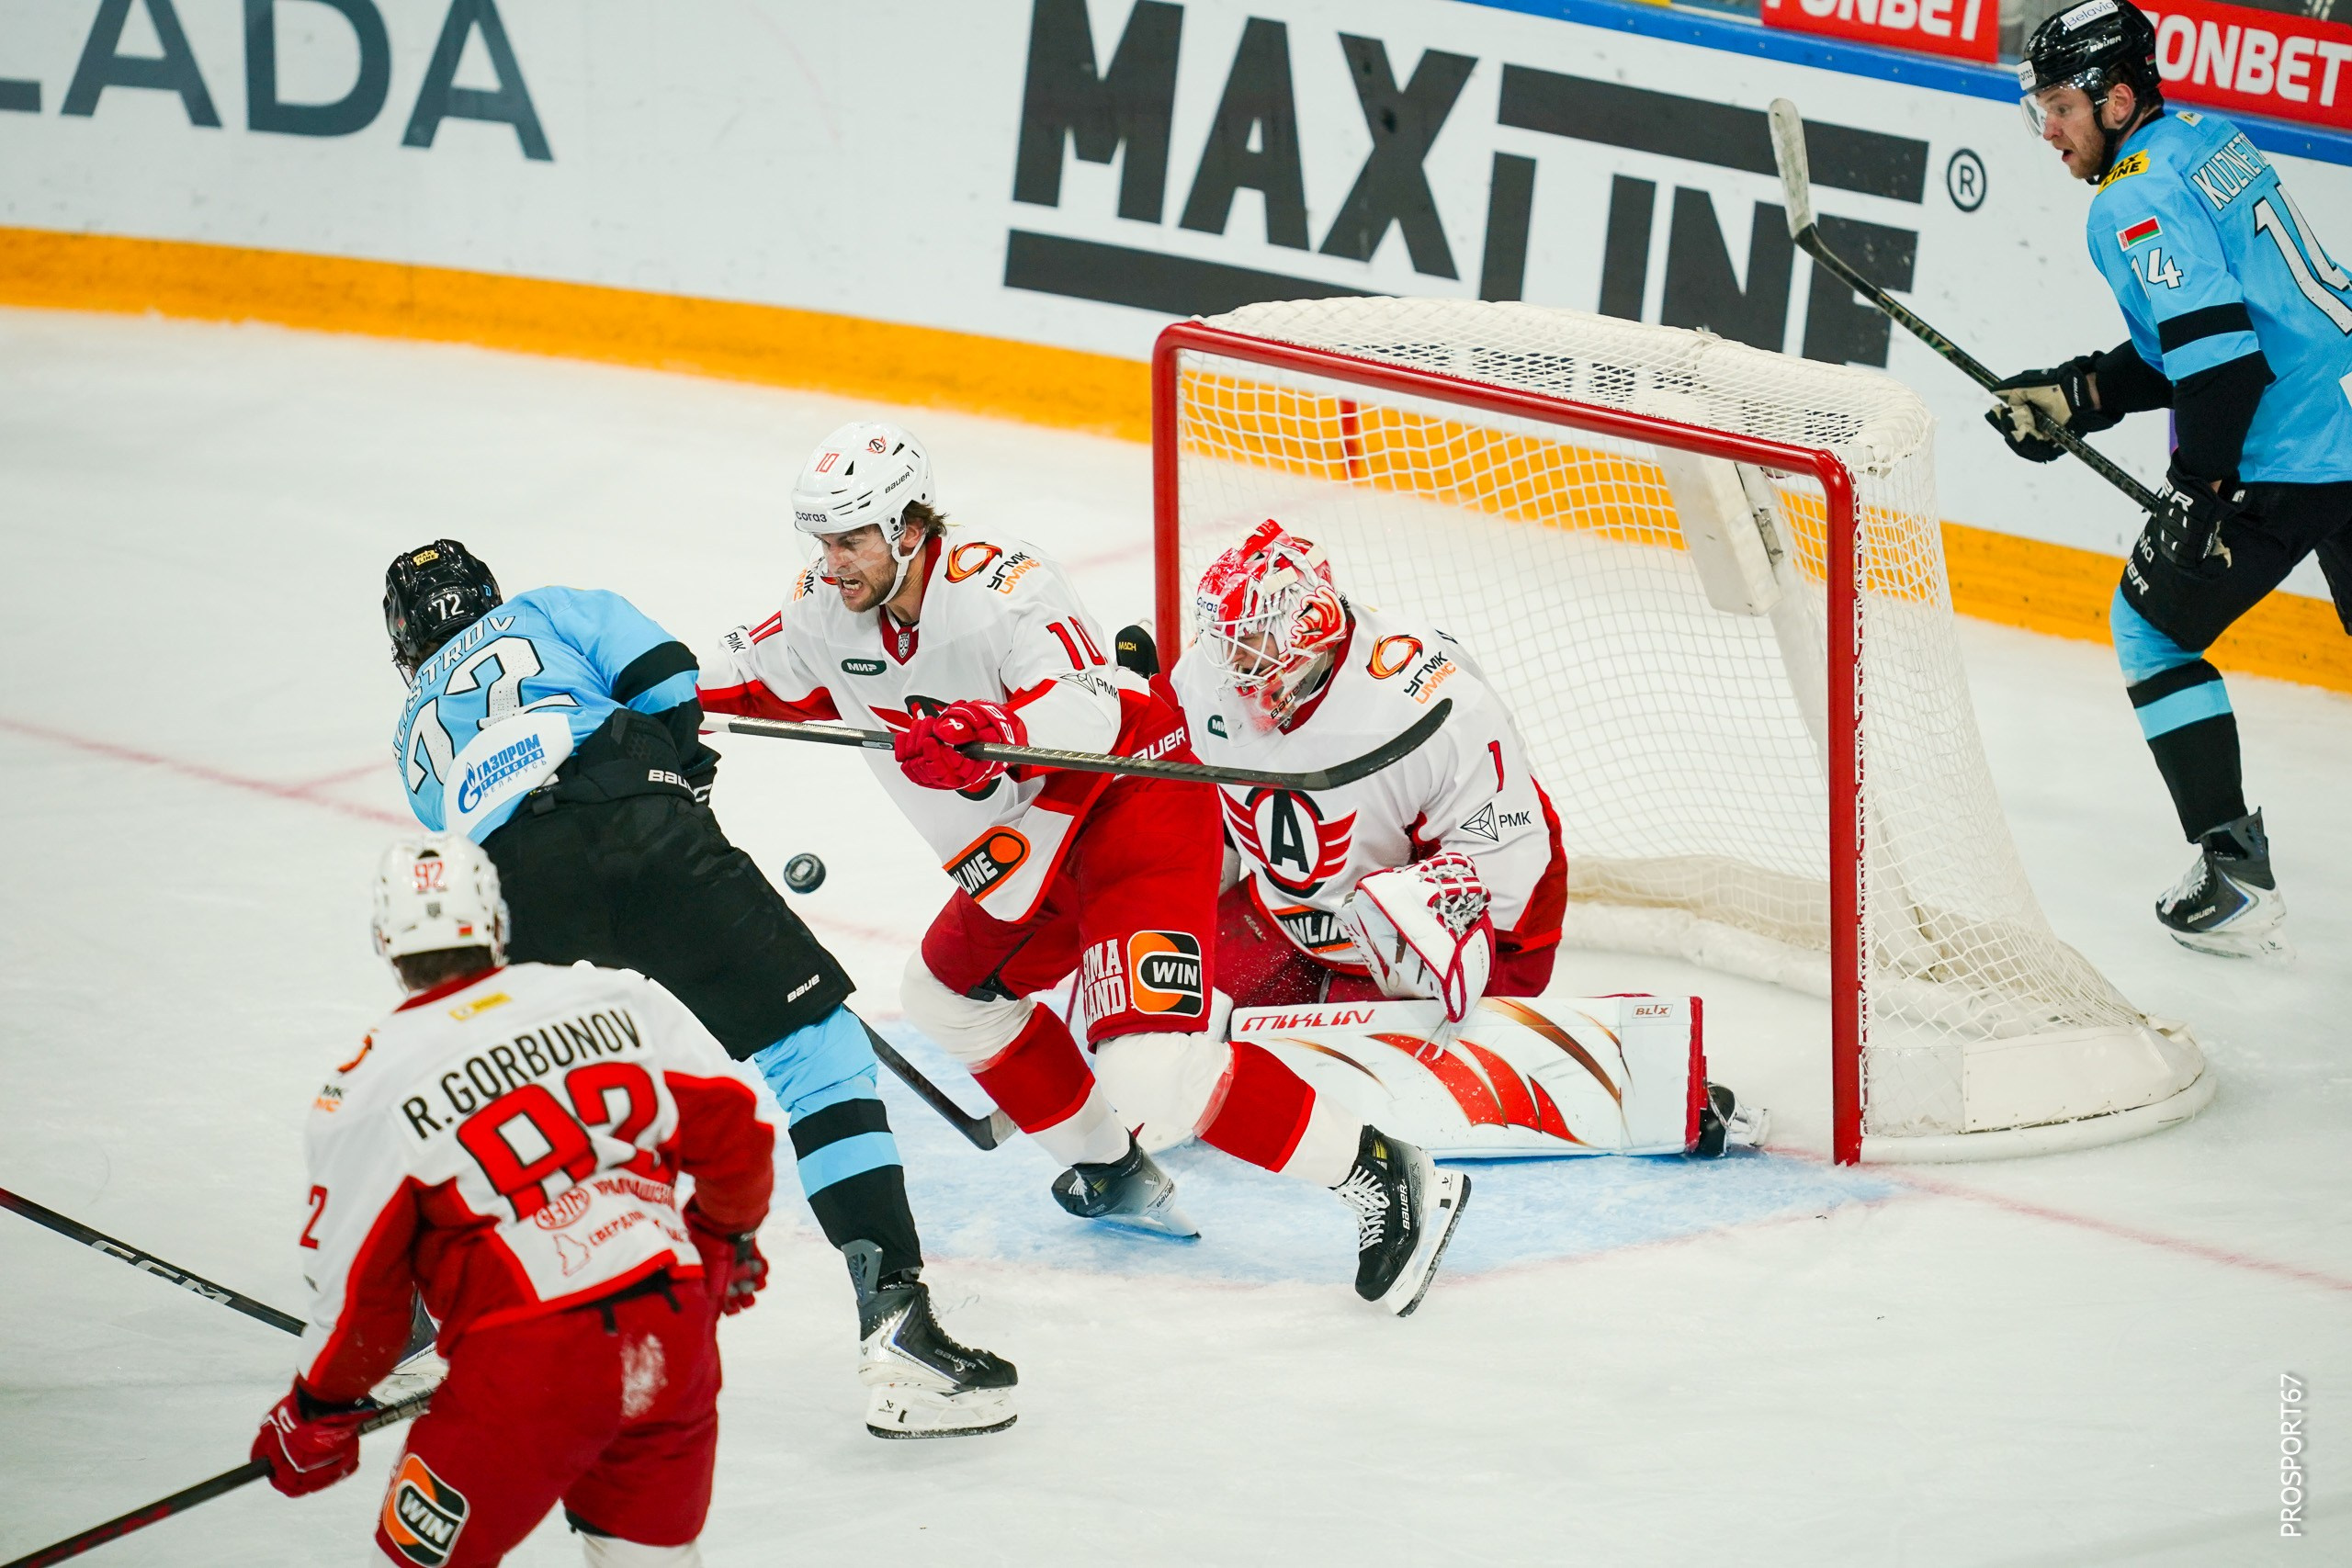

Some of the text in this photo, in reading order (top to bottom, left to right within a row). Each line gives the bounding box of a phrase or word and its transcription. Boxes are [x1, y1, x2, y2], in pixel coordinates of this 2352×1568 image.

[2065, 0, 2116, 27] Belavia
[2089, 35, 2122, 53] BAUER
[2143, 11, 2352, 107] ONBET
[0, 0, 555, 163] ADA
[2191, 131, 2270, 211] KUZNET
[2131, 247, 2185, 302] 14
[815, 453, 840, 473] 10
[885, 471, 910, 494] BAUER
[987, 551, 1030, 591] УГМК
[999, 558, 1041, 595] UMMC
[432, 593, 464, 621] 72
[1117, 641, 1136, 652] MACH
[846, 661, 877, 673] МИР
[1403, 650, 1448, 697] УГМК
[1414, 661, 1457, 705] UMMC
[1270, 680, 1308, 720] BAUER
[1211, 718, 1227, 732] МИ
[476, 733, 541, 782] ГАЗПРОМ
[481, 748, 544, 791] ТРАНСГАЗ
[1487, 739, 1505, 794] 1
[483, 759, 548, 798] БЕЛАРУСЬ
[413, 860, 445, 892] 92
[952, 851, 999, 897] LINE
[1152, 961, 1198, 987] WIN
[1240, 1009, 1375, 1032] MIKLIN
[1634, 1004, 1669, 1017] BLIX
[1400, 1183, 1411, 1231] BAUER
[934, 1348, 977, 1371] BAUER
[398, 1490, 458, 1544] WIN
